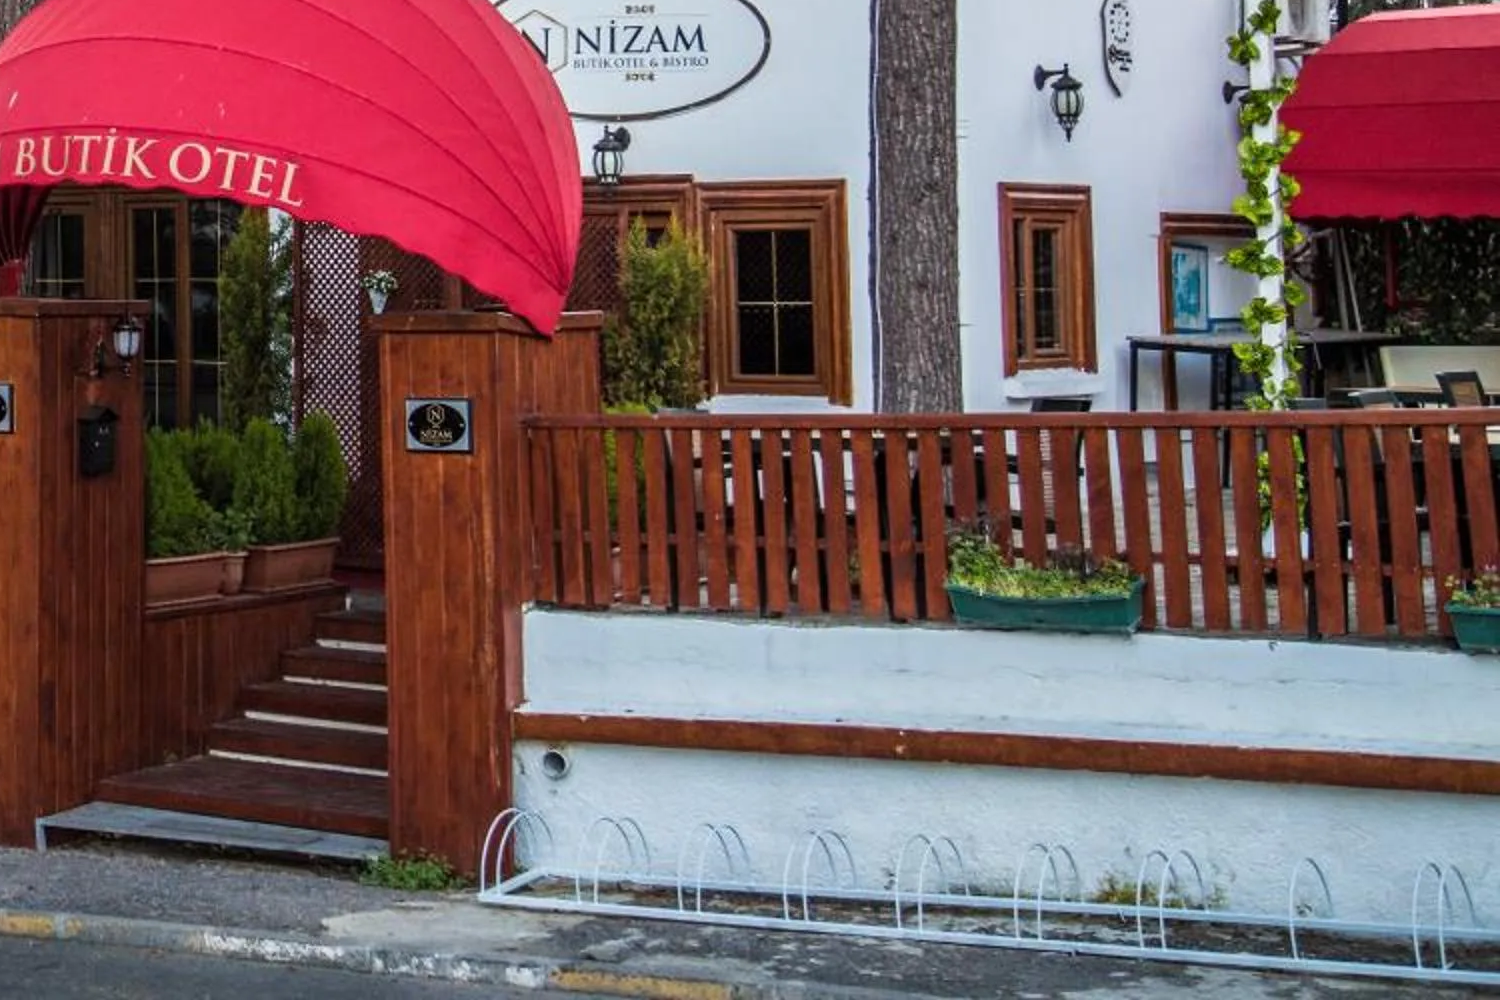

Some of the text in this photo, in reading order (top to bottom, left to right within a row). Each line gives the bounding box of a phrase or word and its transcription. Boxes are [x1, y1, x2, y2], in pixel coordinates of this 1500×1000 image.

[575, 19, 709, 55] NİZAM
[13, 127, 160, 179] BUTİK
[168, 143, 303, 206] OTEL
